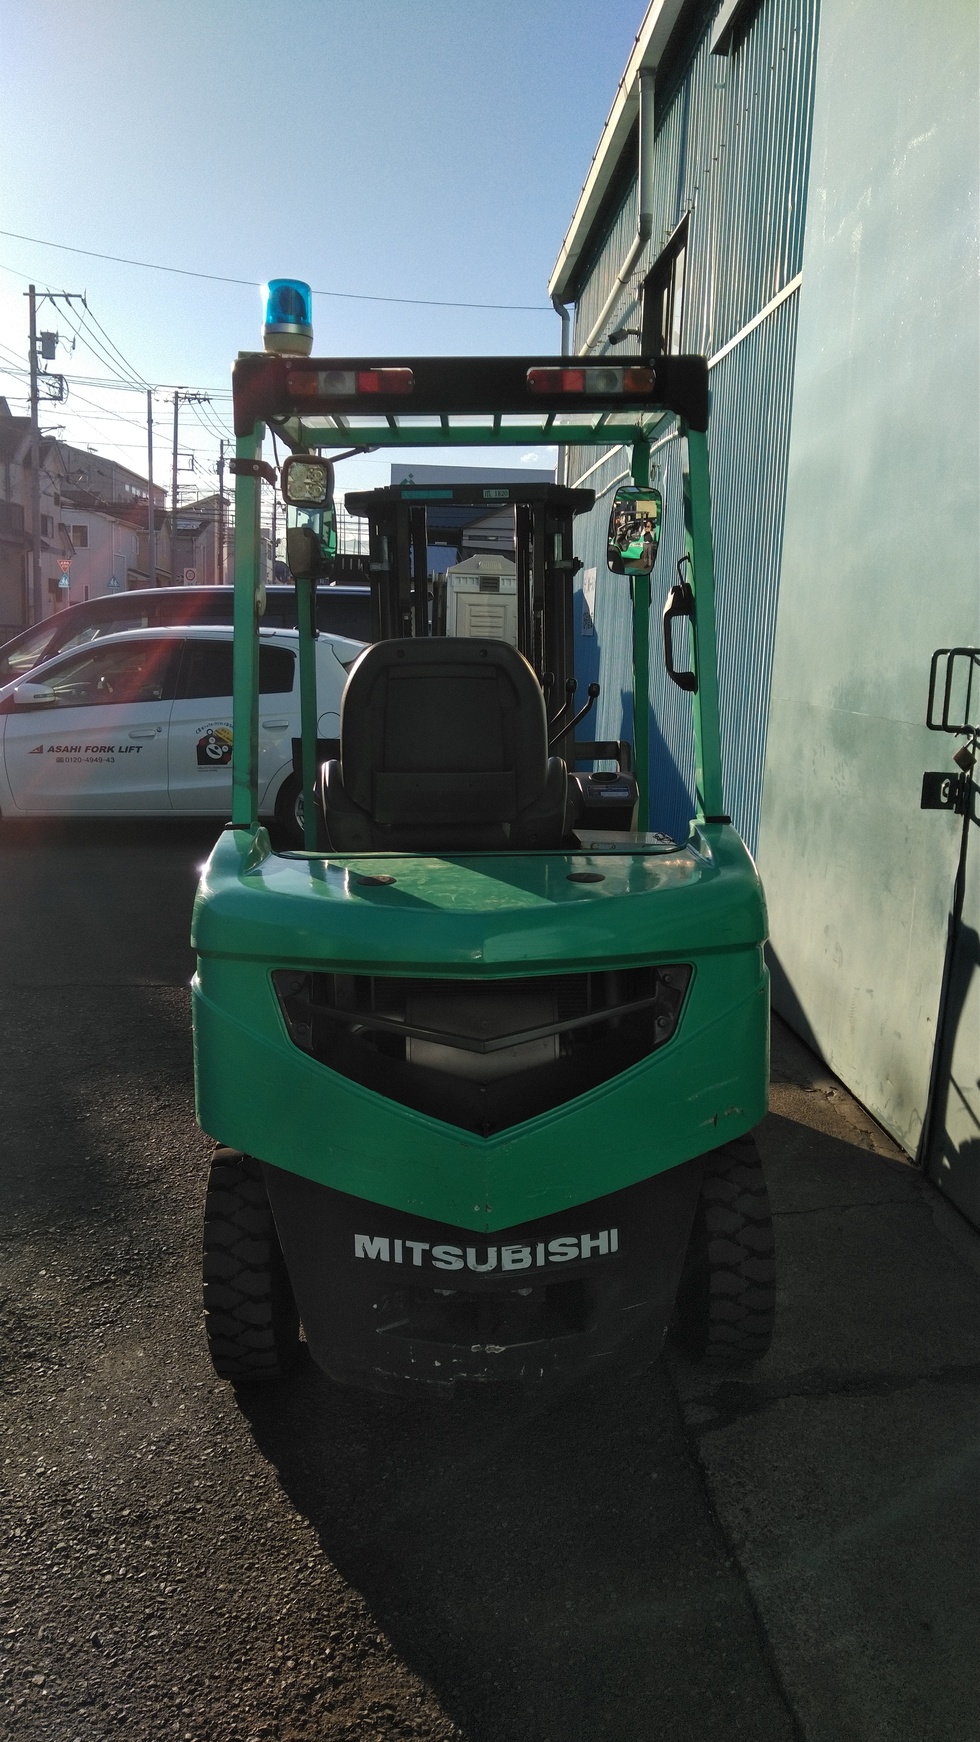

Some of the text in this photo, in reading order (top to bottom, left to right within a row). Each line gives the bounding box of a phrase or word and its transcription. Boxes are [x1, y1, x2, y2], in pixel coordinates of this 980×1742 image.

[47, 745, 143, 754] ASAHI FORK LIFT
[65, 756, 116, 764] 0120-4949-43
[354, 1228, 619, 1273] MITSUBISHI
